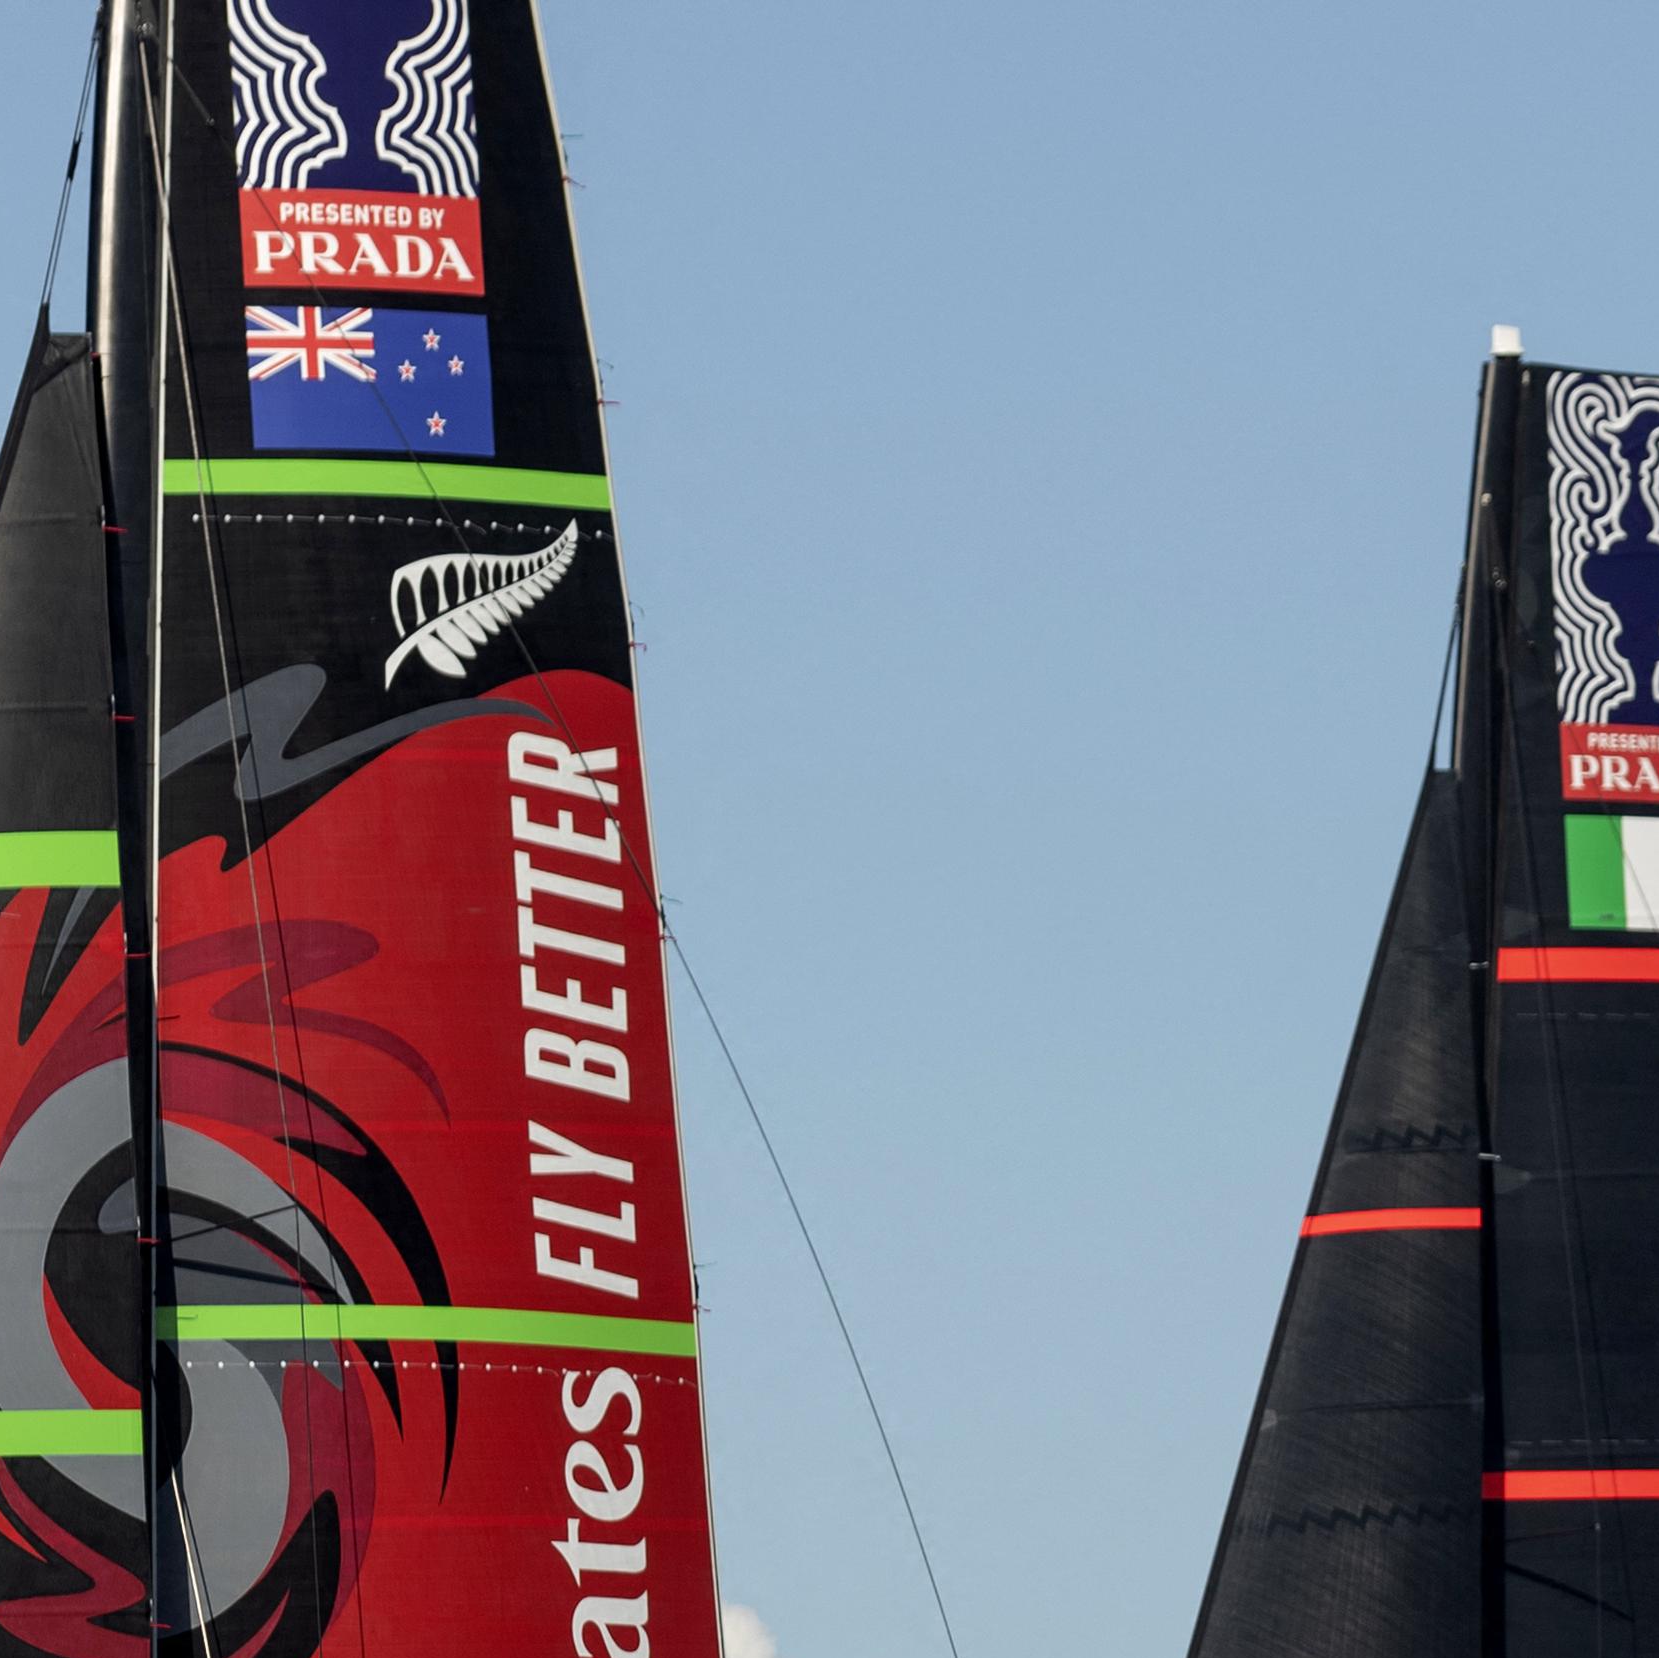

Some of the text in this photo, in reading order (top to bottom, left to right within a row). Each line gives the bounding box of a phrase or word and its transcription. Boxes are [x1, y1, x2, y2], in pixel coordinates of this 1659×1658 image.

[279, 202, 445, 229] PRESENTED BY
[253, 230, 475, 281] PRADA
[507, 731, 640, 1300] FLY BETTER
